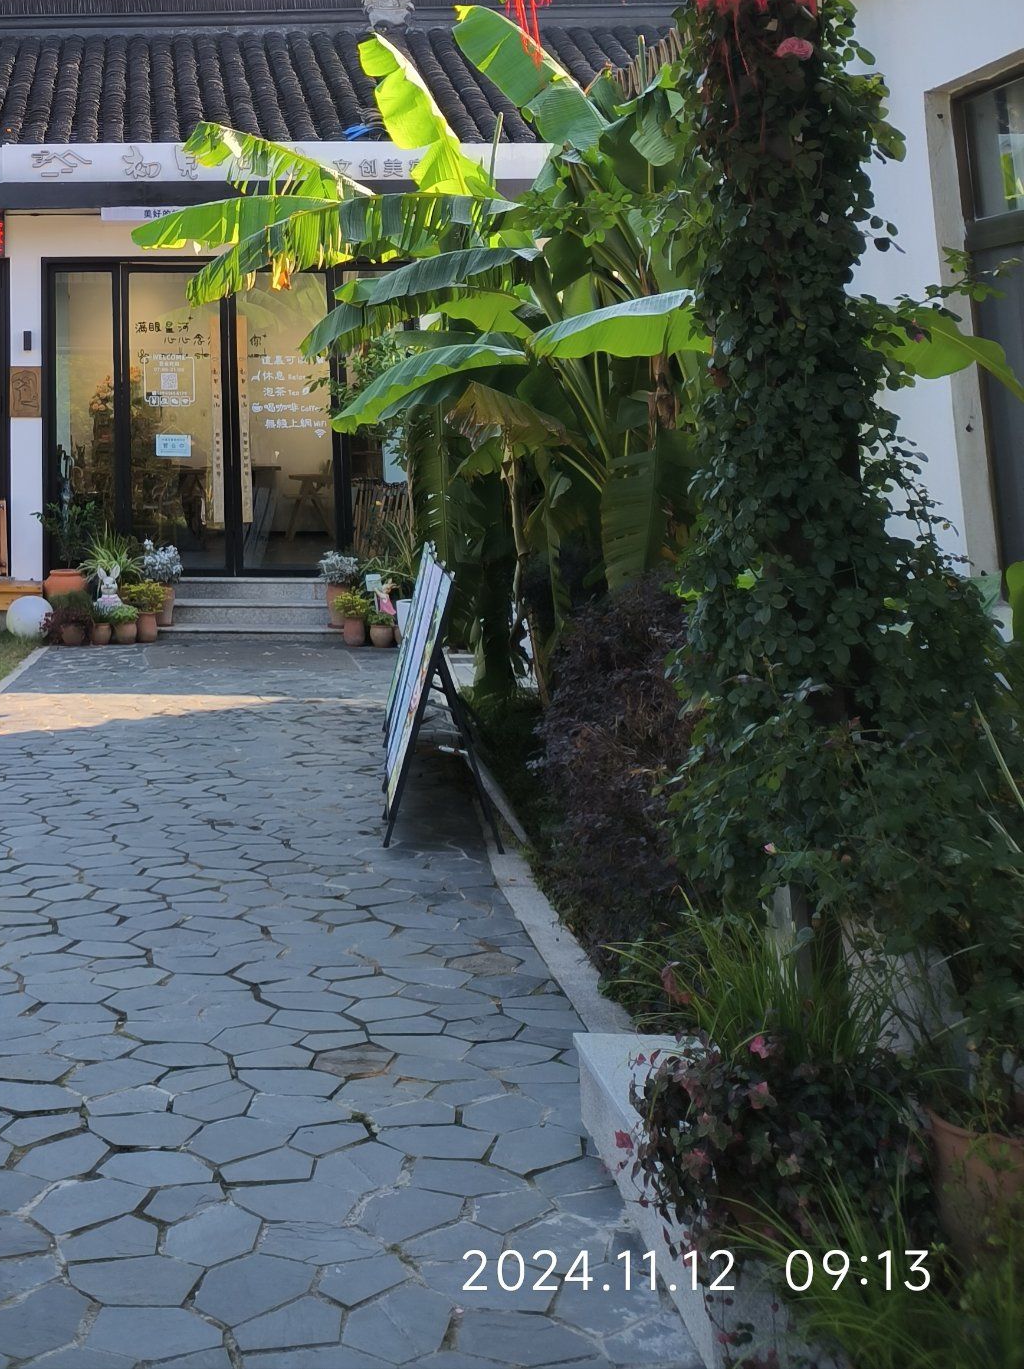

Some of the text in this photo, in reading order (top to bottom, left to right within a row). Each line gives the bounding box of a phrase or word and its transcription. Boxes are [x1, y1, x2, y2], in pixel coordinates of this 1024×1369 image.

[163, 333, 212, 346] 心心念
[262, 371, 285, 381] 休息
[263, 386, 286, 397] 泡茶
